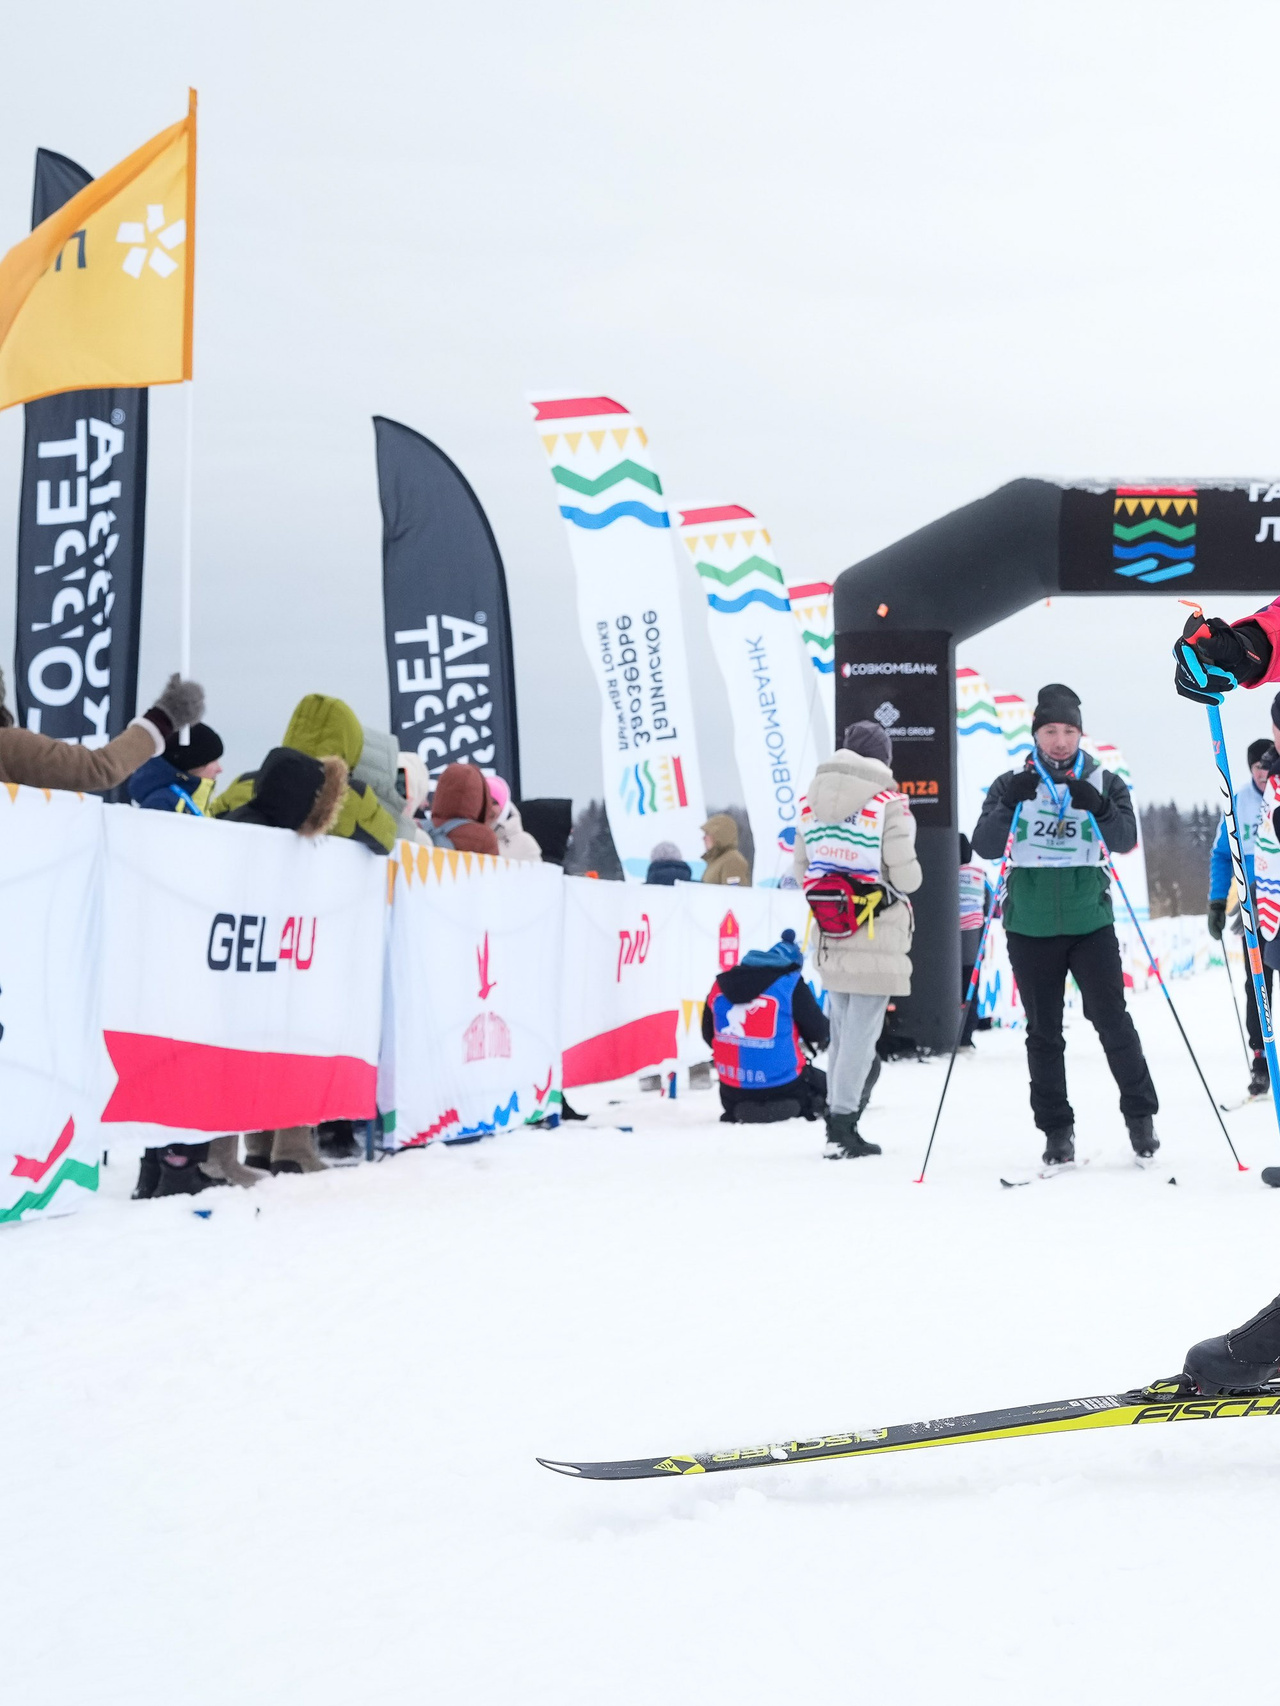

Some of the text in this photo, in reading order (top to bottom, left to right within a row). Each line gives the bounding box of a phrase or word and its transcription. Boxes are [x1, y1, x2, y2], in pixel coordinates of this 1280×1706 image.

[851, 662, 938, 676] СОВКОМБАНК
[1033, 819, 1077, 839] 245
[819, 844, 859, 861] ОНТЁР
